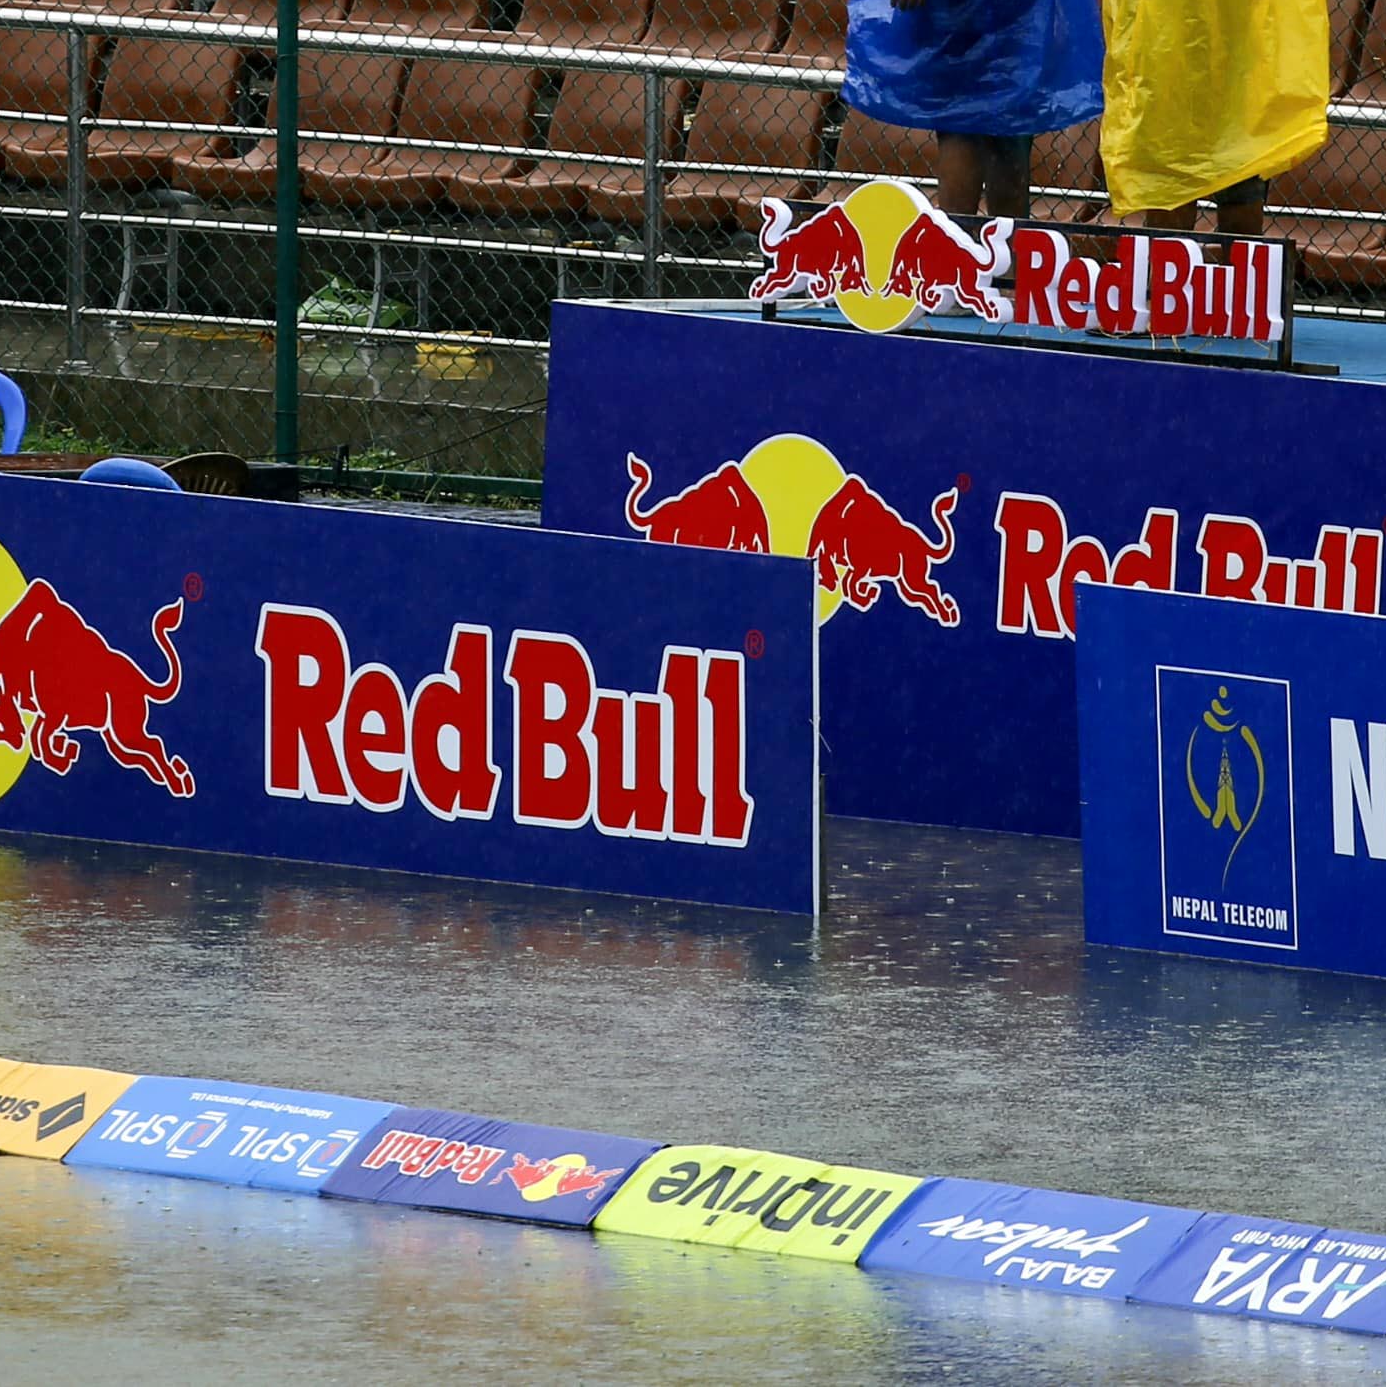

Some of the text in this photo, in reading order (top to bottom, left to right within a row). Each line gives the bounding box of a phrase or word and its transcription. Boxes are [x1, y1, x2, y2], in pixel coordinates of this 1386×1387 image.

[1014, 228, 1284, 342] Red Bull
[255, 602, 754, 849] Red Bull
[1172, 895, 1288, 932] NEPAL TELECOM
[99, 1108, 307, 1163] SPIL SPIL
[360, 1129, 506, 1186] Red Bull
[647, 1161, 894, 1247] inDrive
[917, 1215, 1150, 1268] pulsar
[993, 1256, 1116, 1290] BAJAJ
